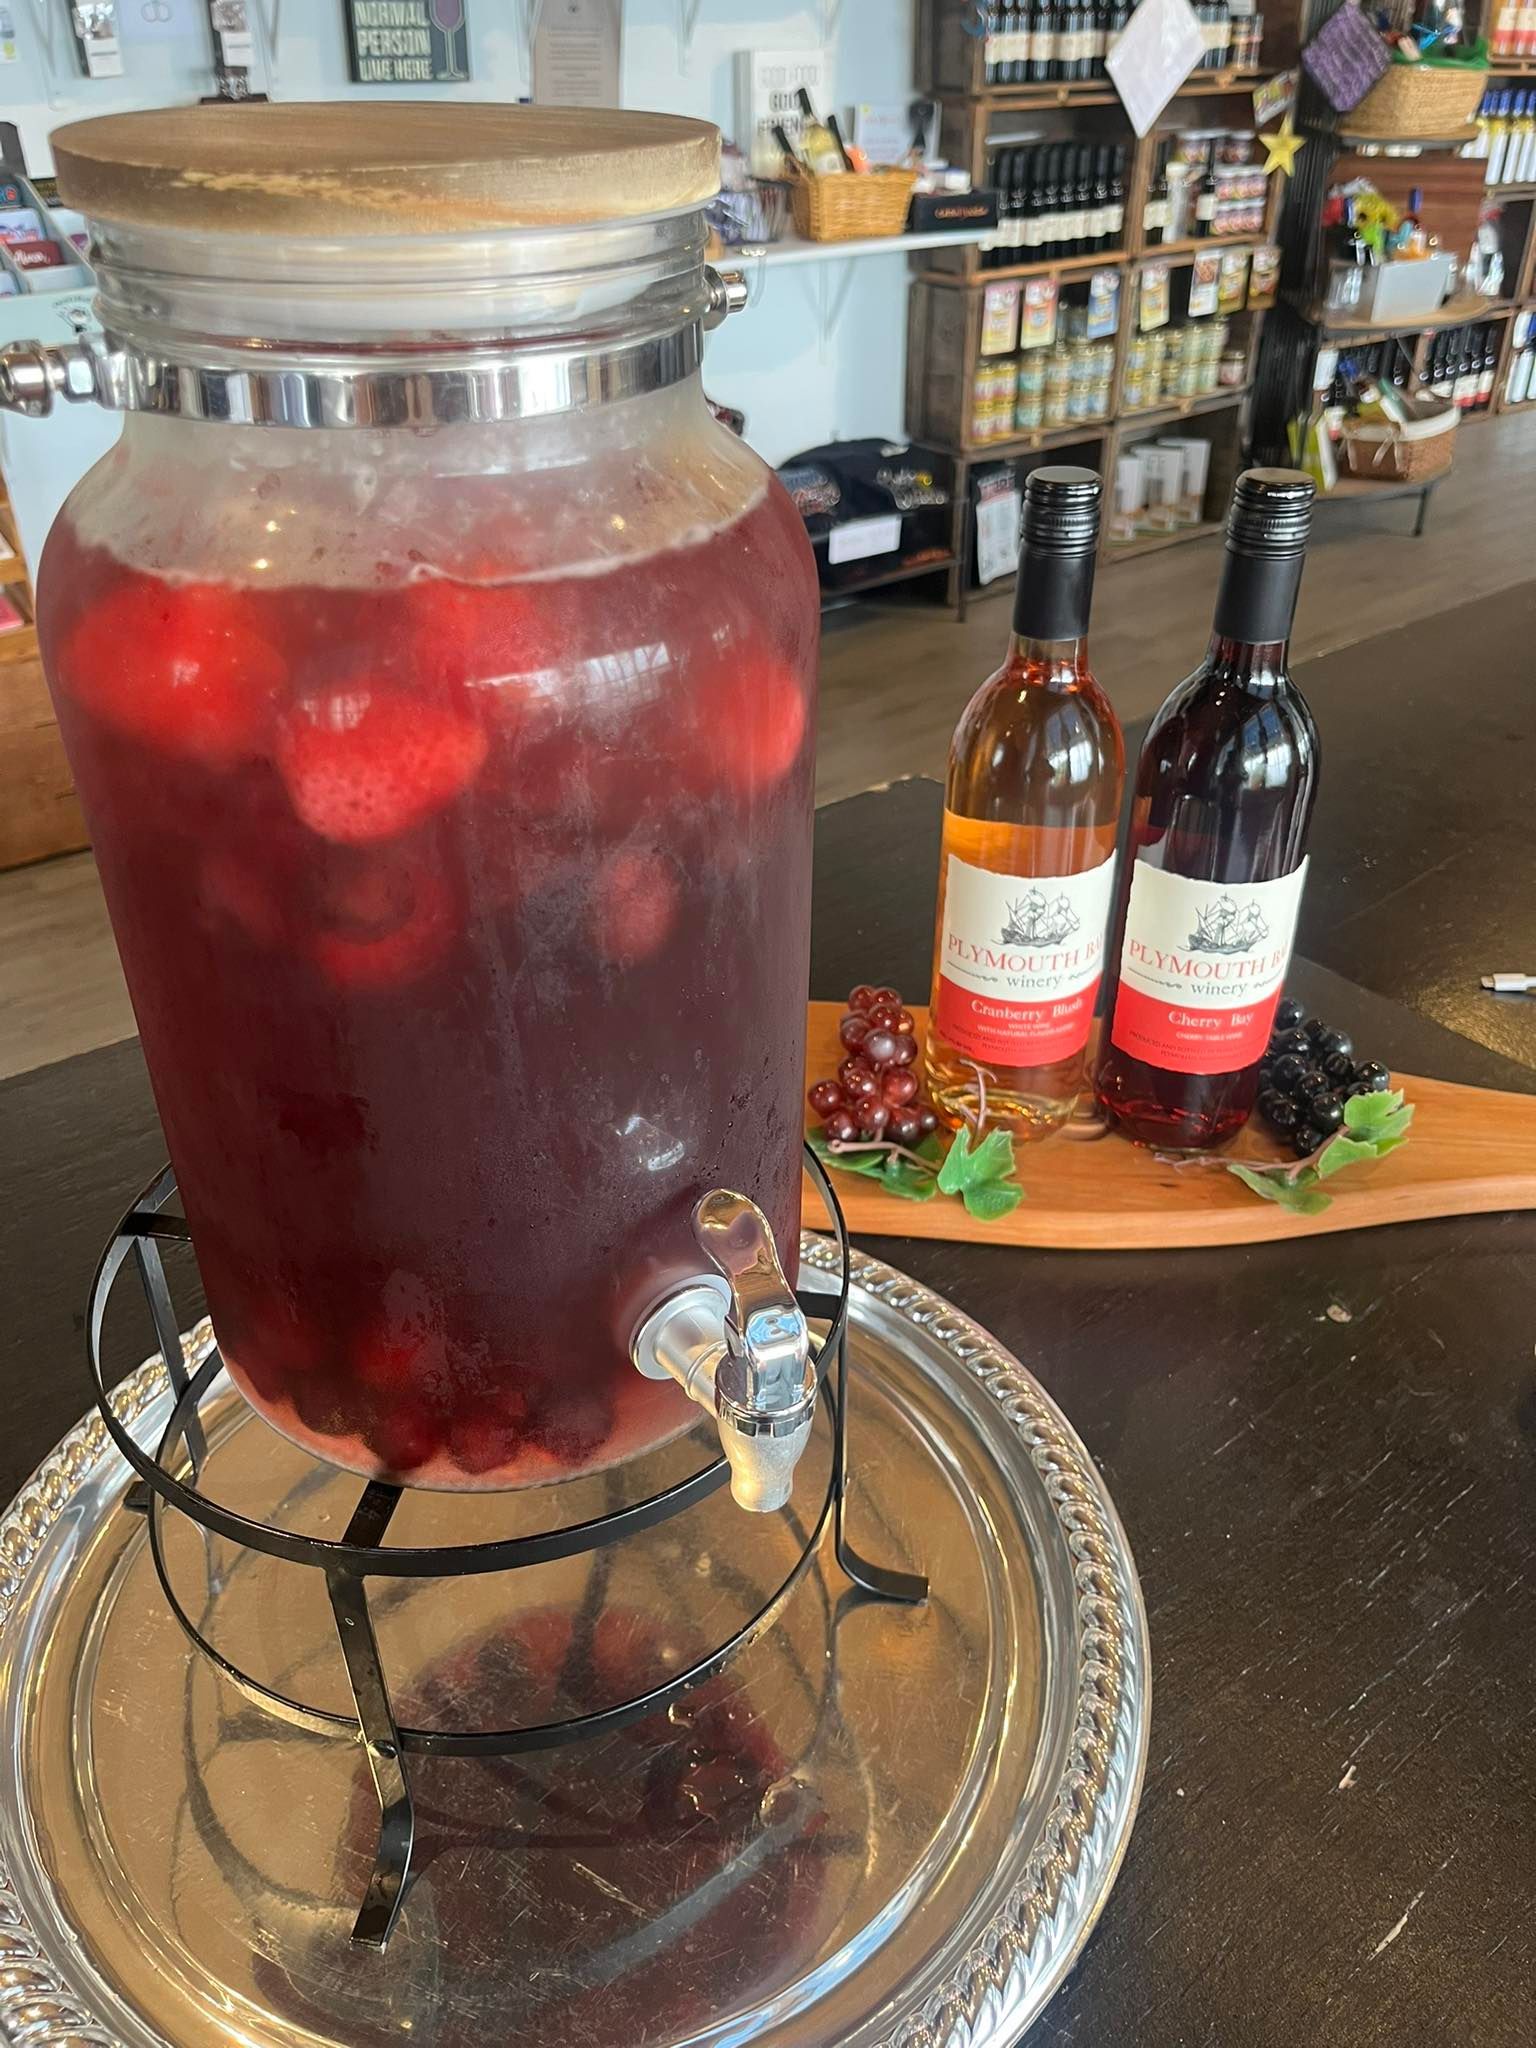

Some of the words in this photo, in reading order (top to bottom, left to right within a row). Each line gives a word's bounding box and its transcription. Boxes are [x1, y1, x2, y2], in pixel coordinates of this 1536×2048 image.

[354, 1, 430, 26] NORMAL
[357, 28, 431, 56] PERSON
[359, 58, 394, 81] LIVE
[394, 58, 433, 81] HERE
[948, 934, 1080, 972] PLYMOUTH
[1129, 939, 1266, 980] PLYMOUTH
[1007, 974, 1062, 990] winery
[1191, 981, 1247, 997] winery
[971, 999, 1043, 1022] Cranberry
[1052, 998, 1083, 1018] Blush
[1168, 1010, 1222, 1029] Cherry
[1231, 1010, 1254, 1028] Bay
